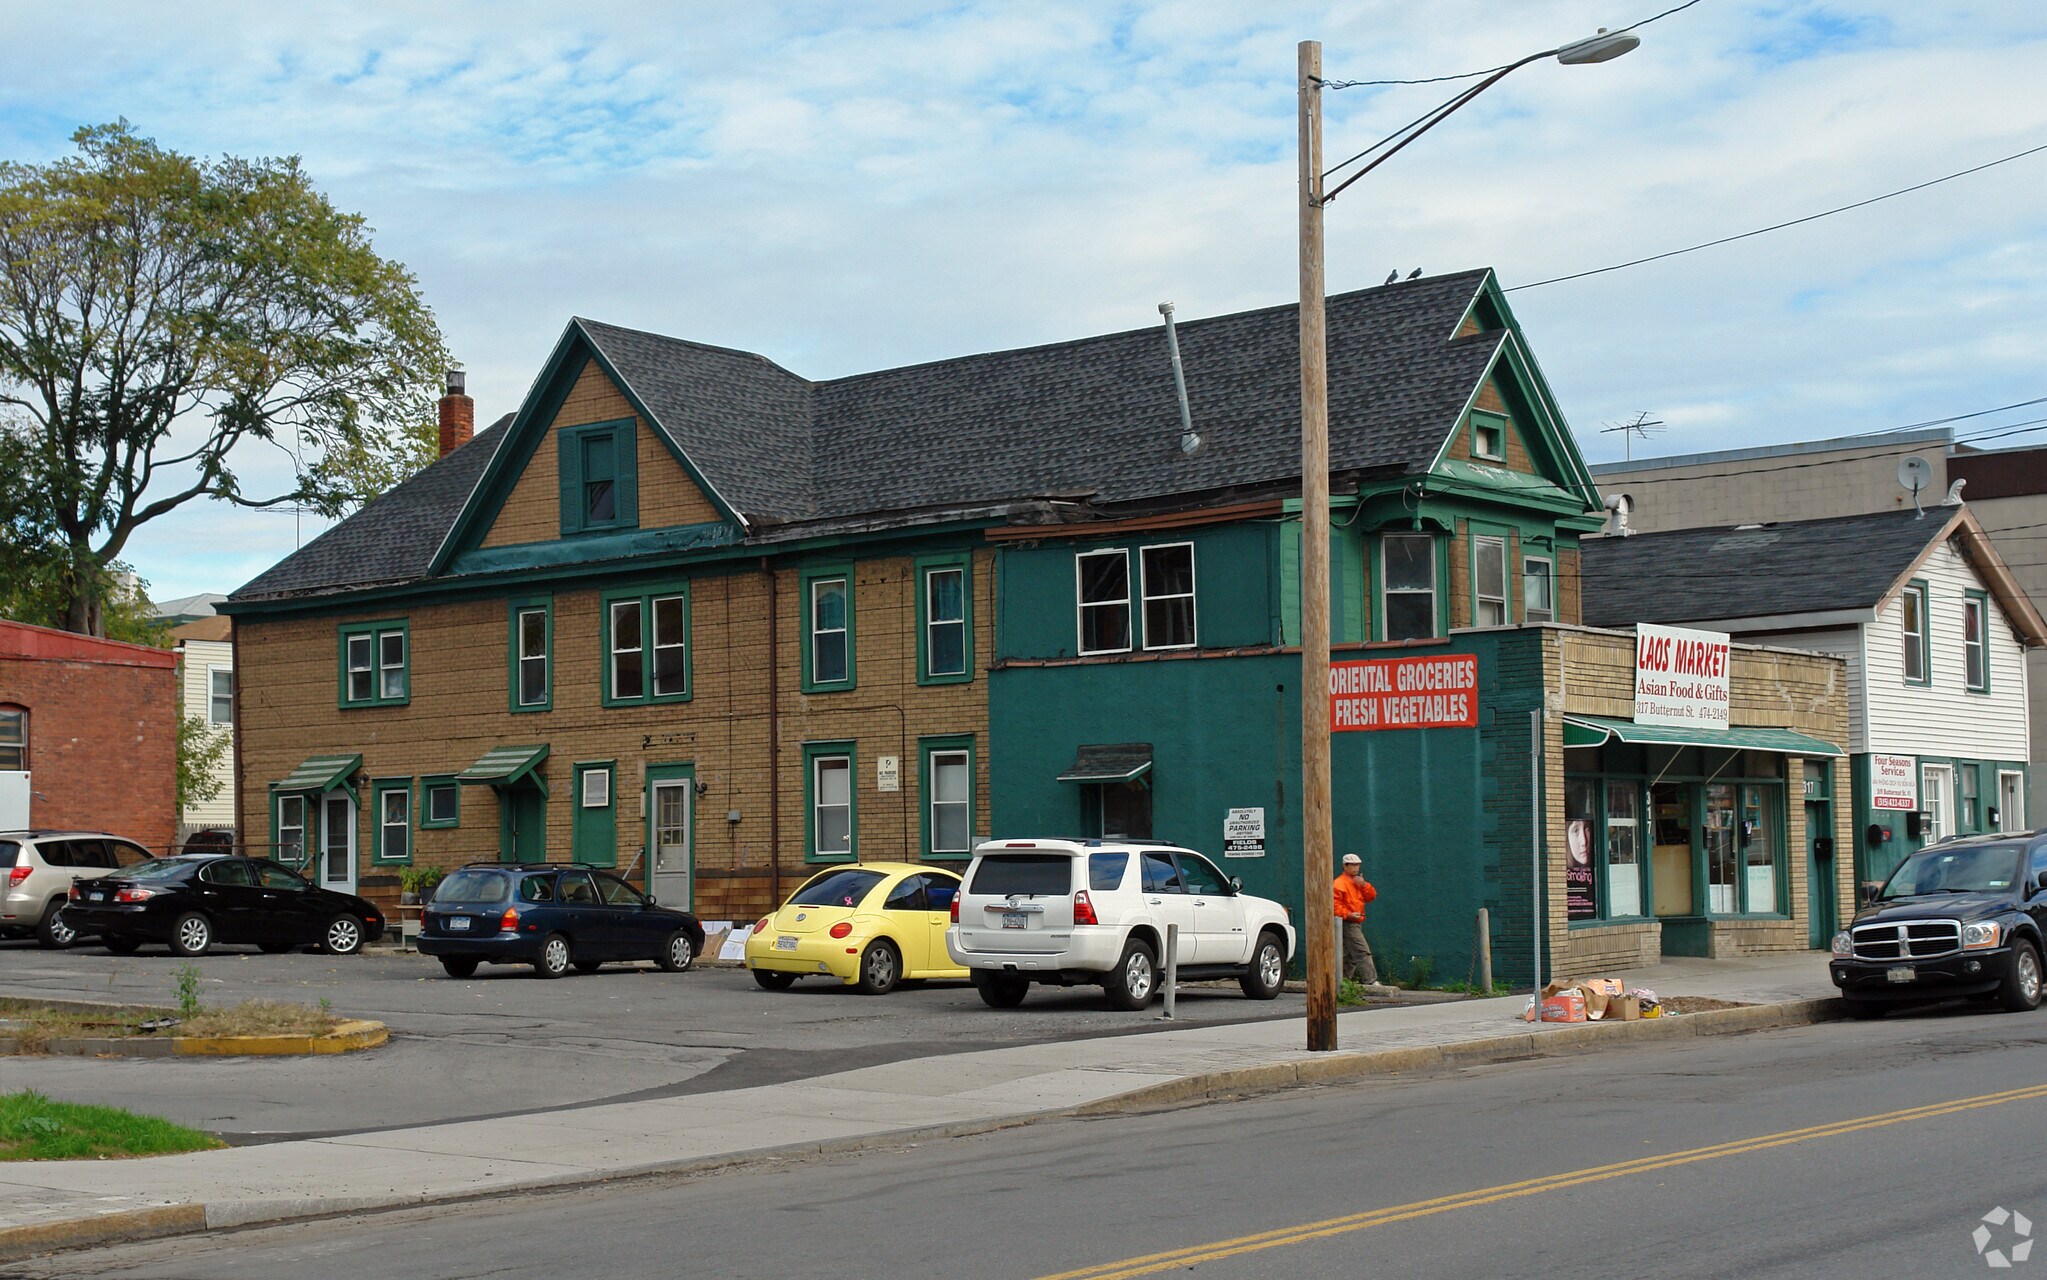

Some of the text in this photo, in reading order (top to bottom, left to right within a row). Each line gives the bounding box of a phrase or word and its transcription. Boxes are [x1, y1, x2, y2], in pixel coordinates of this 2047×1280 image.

[1639, 634, 1728, 679] LAOS MARKET
[1329, 660, 1475, 695] ORIENTAL GROCERIES
[1637, 678, 1728, 701] Asian Food & Gifts
[1335, 694, 1468, 726] FRESH VEGETABLES
[1636, 702, 1649, 714] 317
[1650, 702, 1685, 717] Butternut
[1874, 755, 1912, 767] Four Seasons
[1881, 766, 1906, 776] Services
[1803, 780, 1814, 794] 317
[1566, 869, 1593, 885] Smoking
